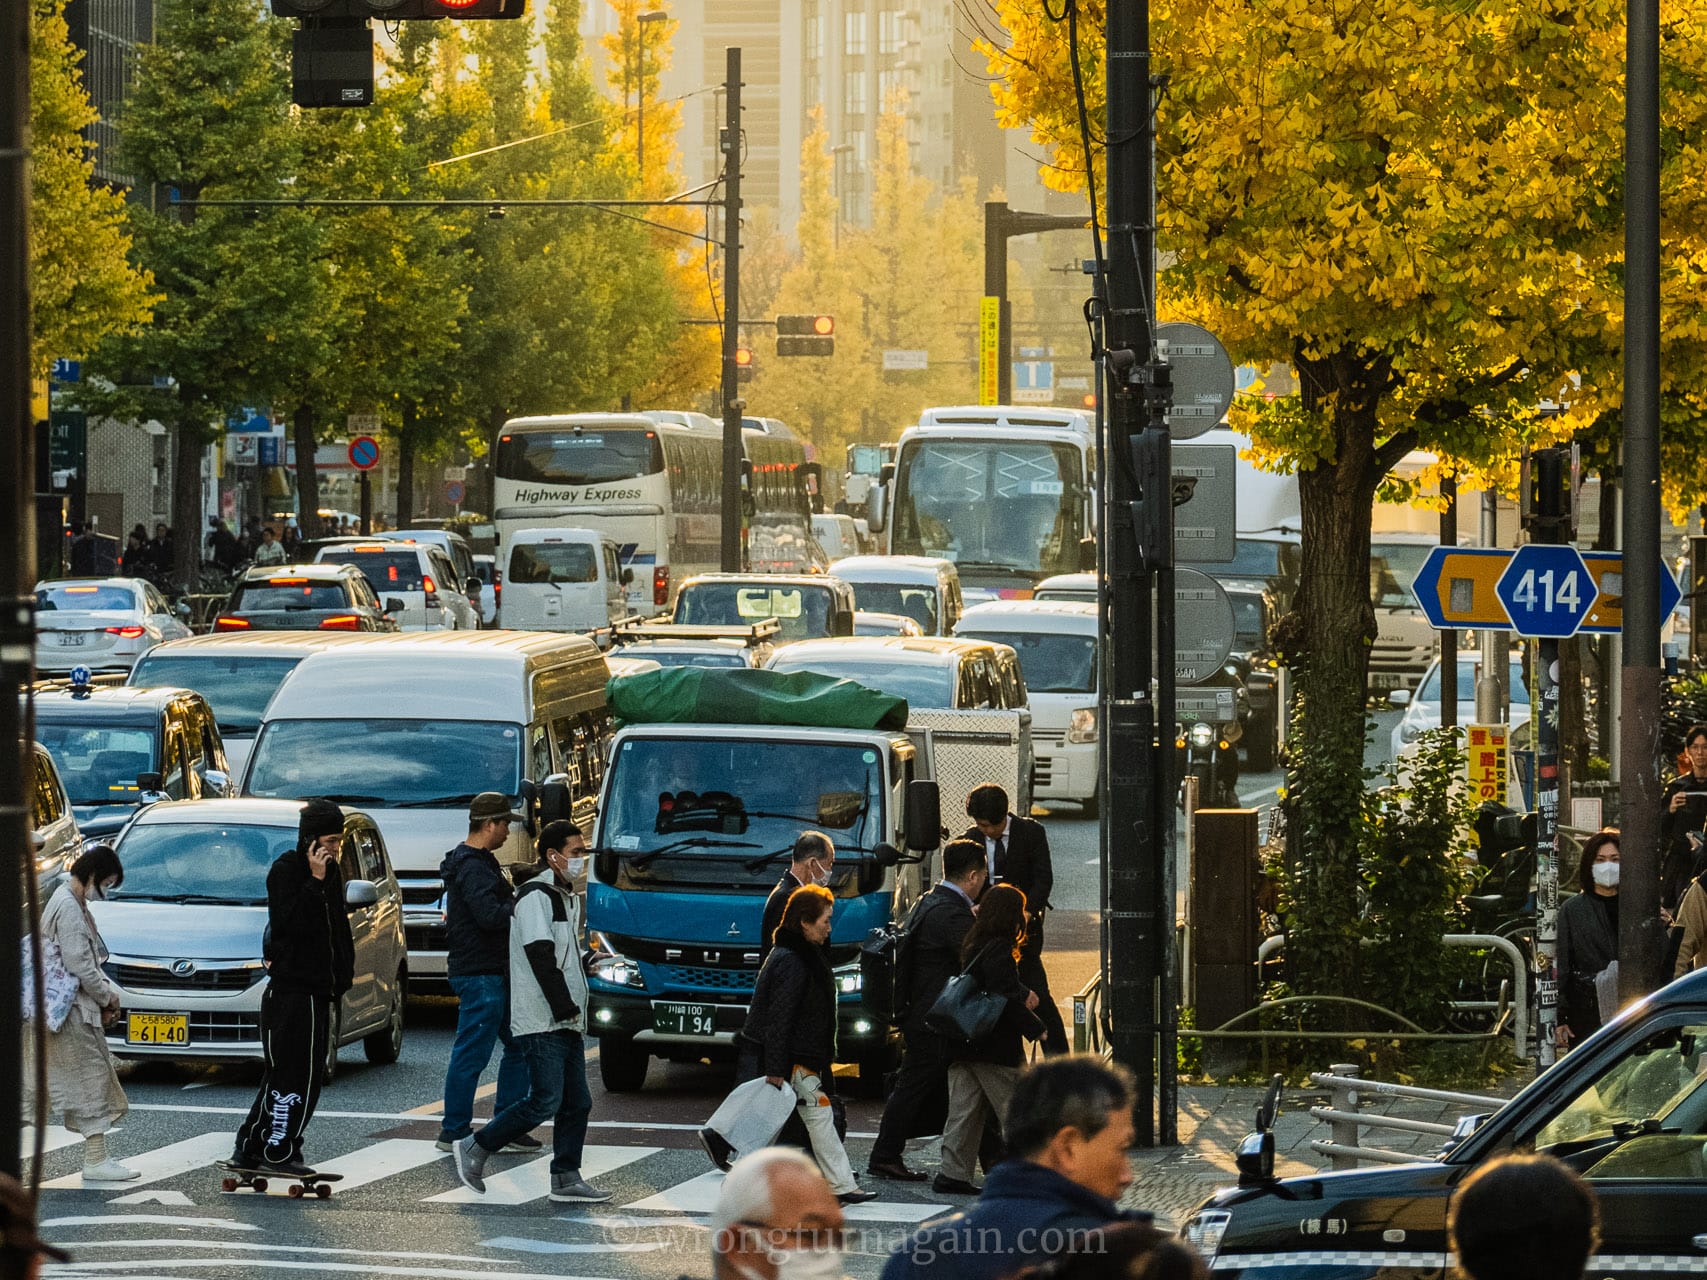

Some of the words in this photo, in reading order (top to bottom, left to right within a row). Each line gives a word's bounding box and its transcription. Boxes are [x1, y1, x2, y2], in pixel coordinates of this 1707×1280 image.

[515, 488, 578, 504] Highway
[584, 487, 642, 502] Express
[1513, 569, 1581, 613] 414
[666, 949, 760, 964] FUS
[687, 1006, 703, 1015] 100
[160, 1016, 176, 1024] 580
[141, 1026, 185, 1042] 61-40
[267, 1090, 301, 1146] Supreme
